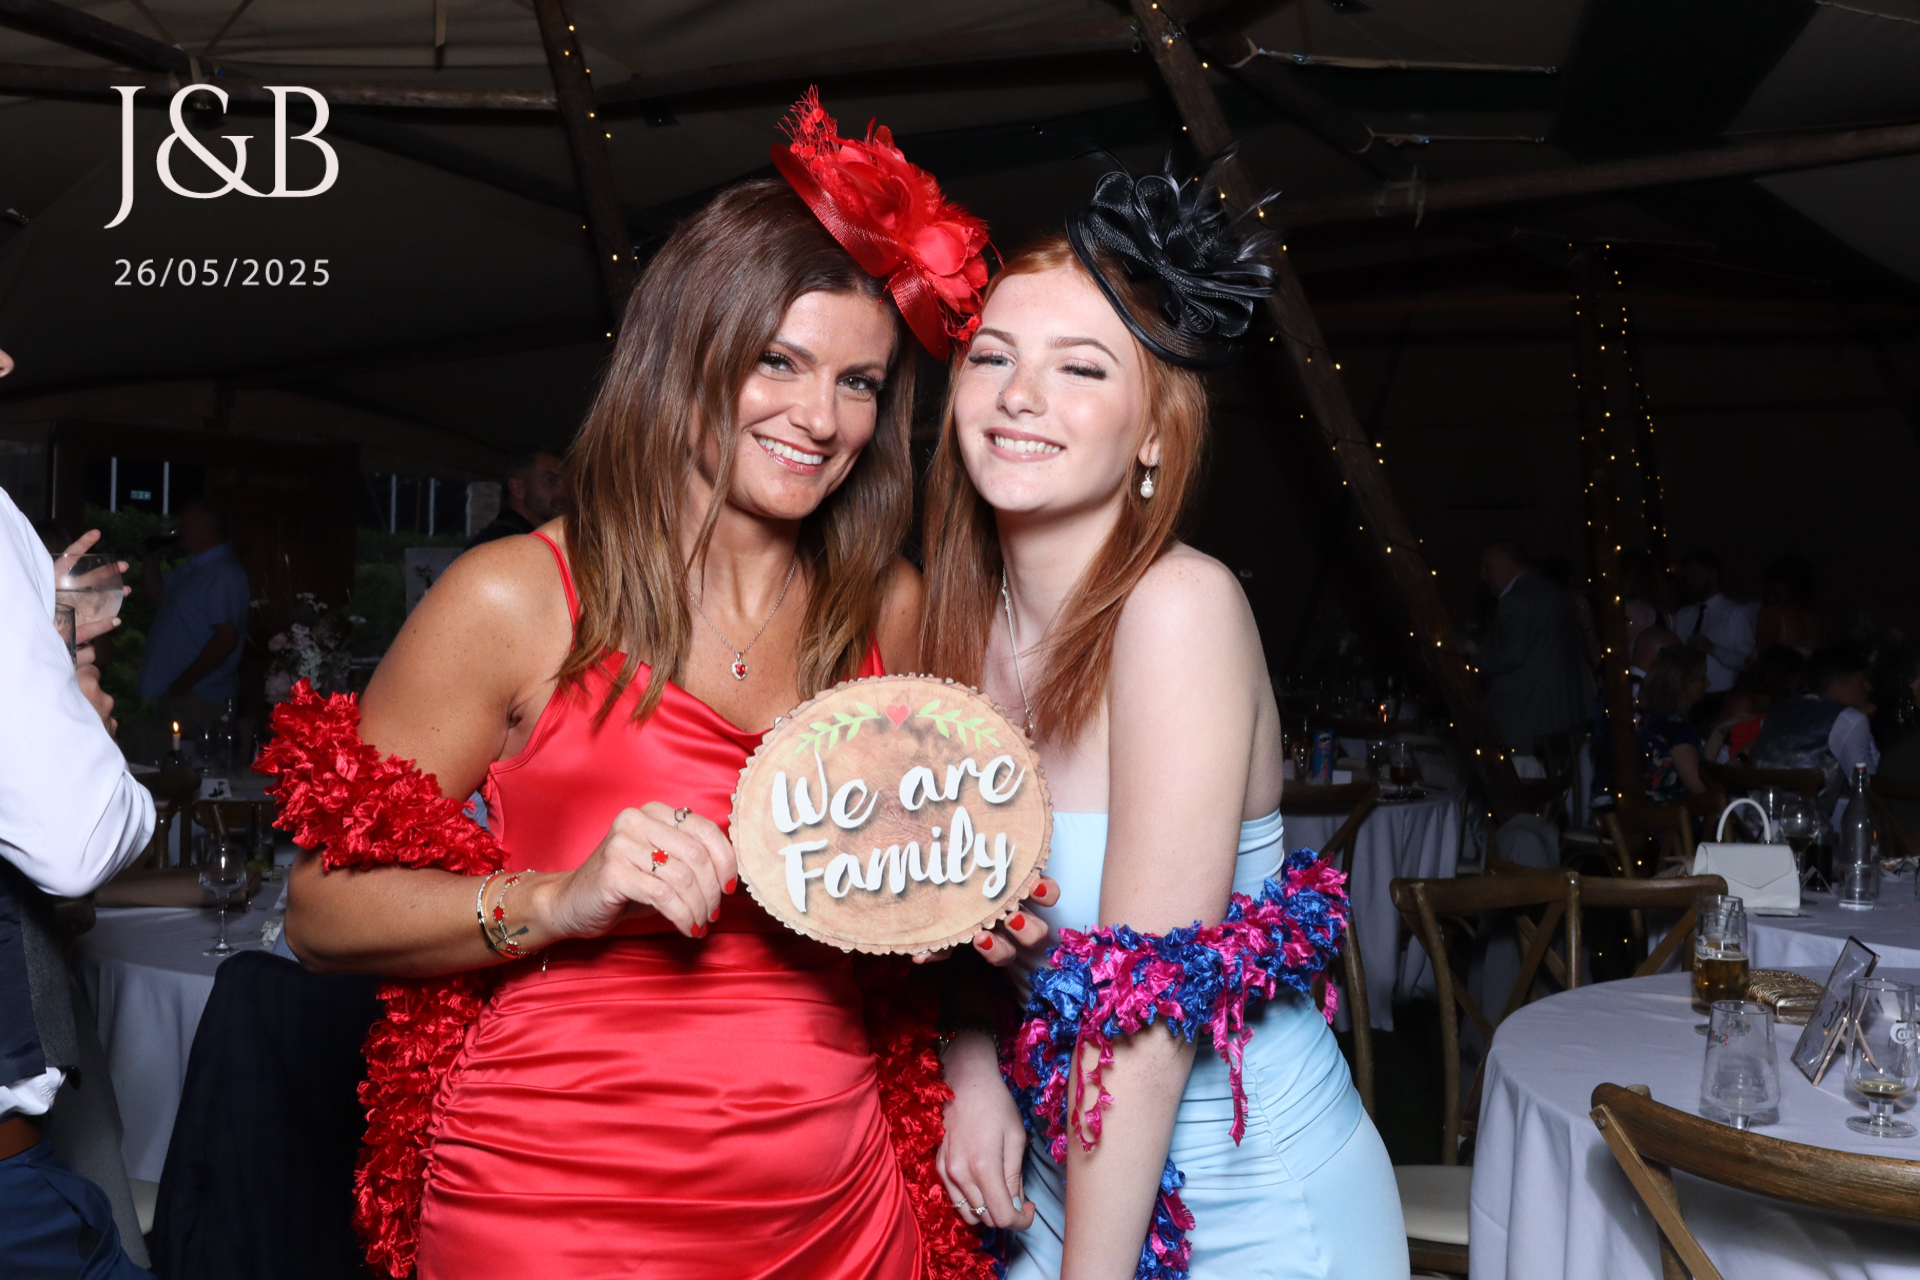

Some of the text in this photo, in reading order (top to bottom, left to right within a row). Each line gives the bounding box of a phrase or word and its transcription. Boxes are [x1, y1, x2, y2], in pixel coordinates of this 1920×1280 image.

[771, 750, 1026, 833] We are
[778, 806, 1016, 913] Family
